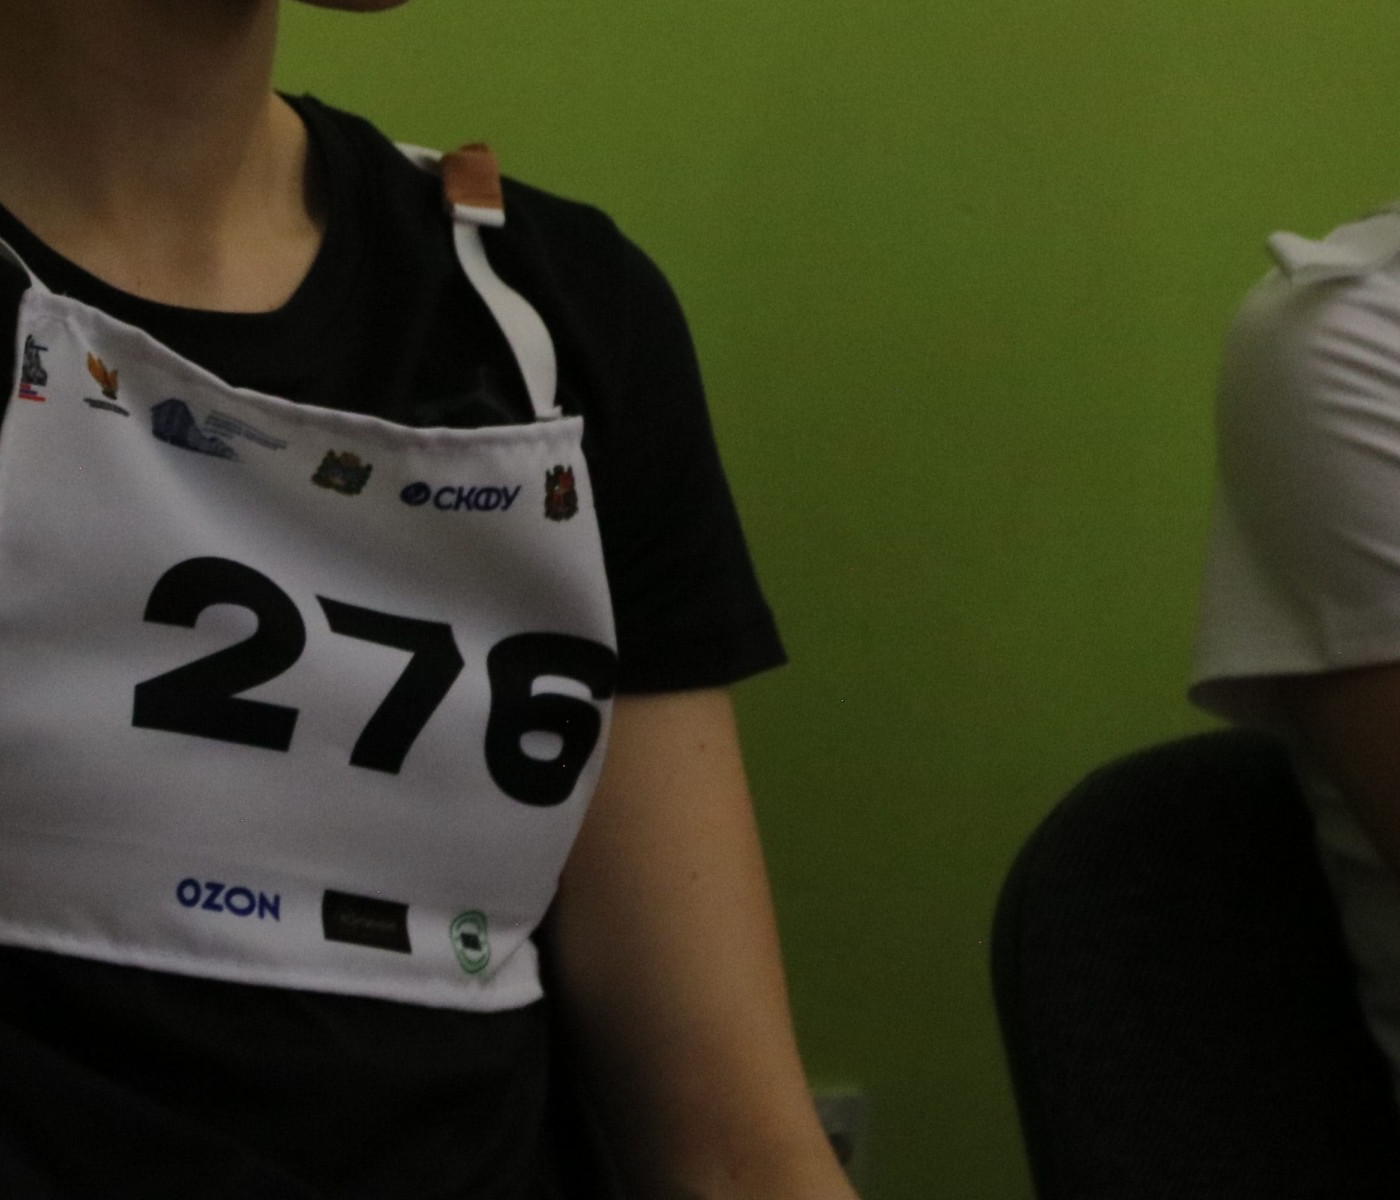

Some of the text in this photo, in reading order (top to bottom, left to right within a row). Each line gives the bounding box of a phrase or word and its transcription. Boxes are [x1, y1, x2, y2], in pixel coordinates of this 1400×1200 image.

[433, 485, 521, 511] СКФУ
[132, 557, 619, 807] 276
[176, 878, 280, 921] OZON
